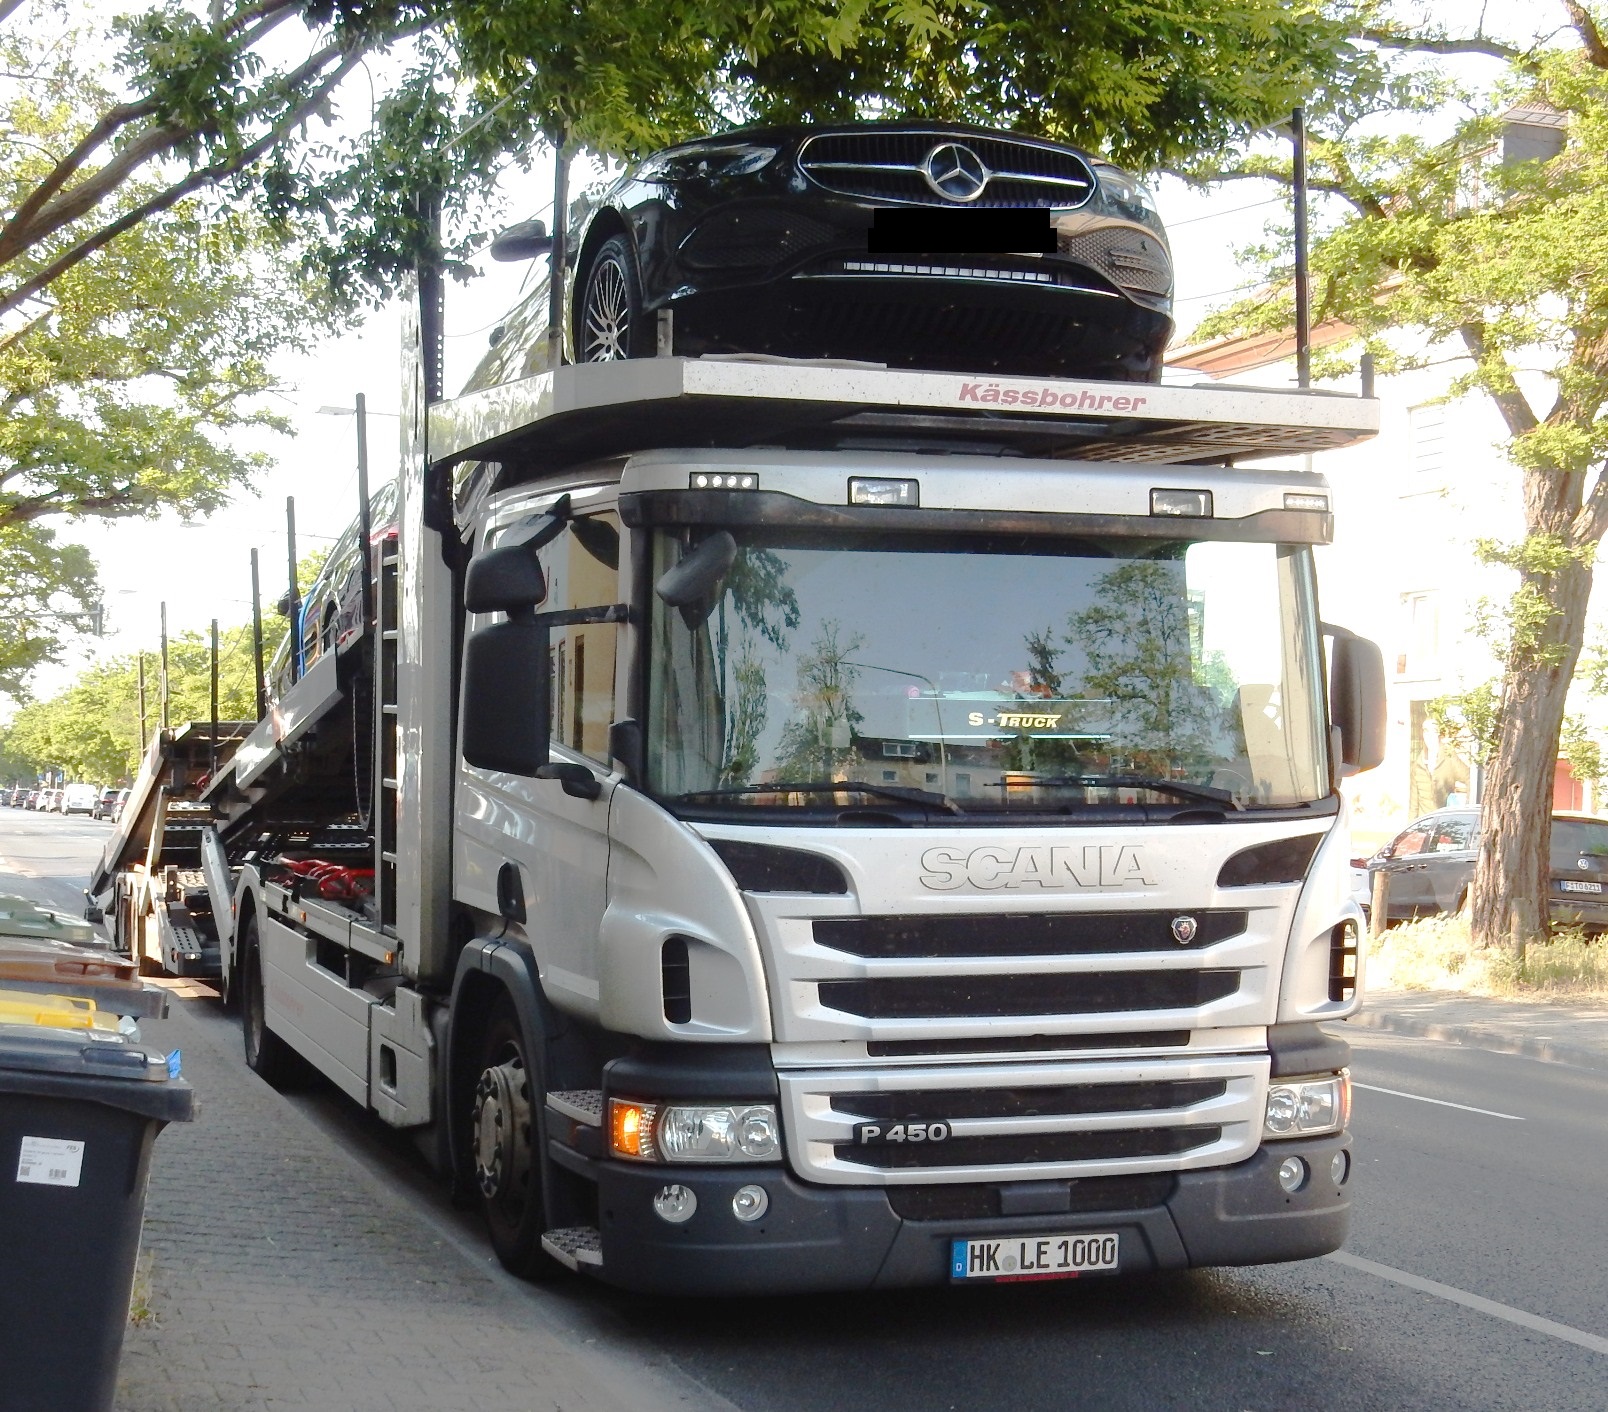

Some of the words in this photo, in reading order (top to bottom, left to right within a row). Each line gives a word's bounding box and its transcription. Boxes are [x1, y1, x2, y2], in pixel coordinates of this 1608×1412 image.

[959, 383, 1147, 411] Kässbohrer
[919, 845, 1158, 890] SCANIA
[861, 1125, 881, 1144] P
[885, 1123, 948, 1143] 450
[955, 1262, 963, 1272] D
[969, 1243, 1001, 1272] HK
[1020, 1241, 1051, 1270] LE
[1057, 1237, 1116, 1268] 1000
